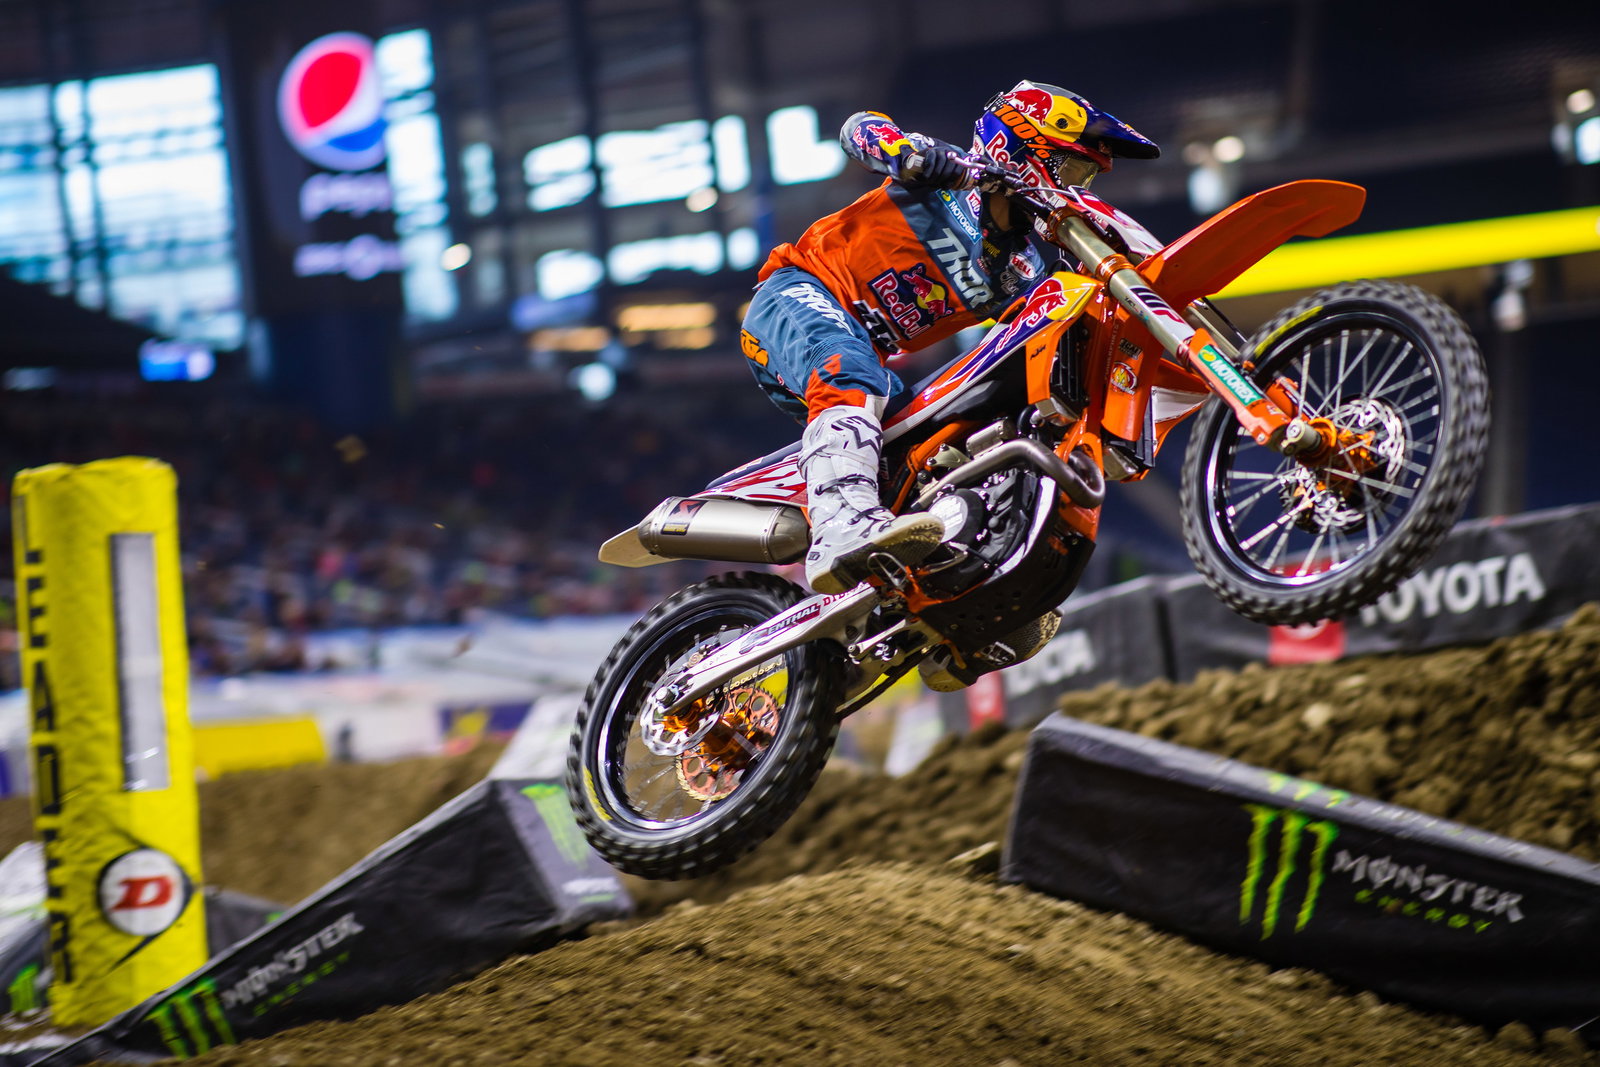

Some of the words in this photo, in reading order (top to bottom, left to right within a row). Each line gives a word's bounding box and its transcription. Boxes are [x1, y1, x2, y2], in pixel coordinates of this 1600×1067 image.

[994, 104, 1056, 159] 100%
[948, 200, 981, 240] MOTOREX
[927, 227, 994, 309] THOR
[872, 272, 916, 320] Red
[1210, 359, 1259, 405] MOTOREX
[1332, 849, 1524, 923] MONSTER
